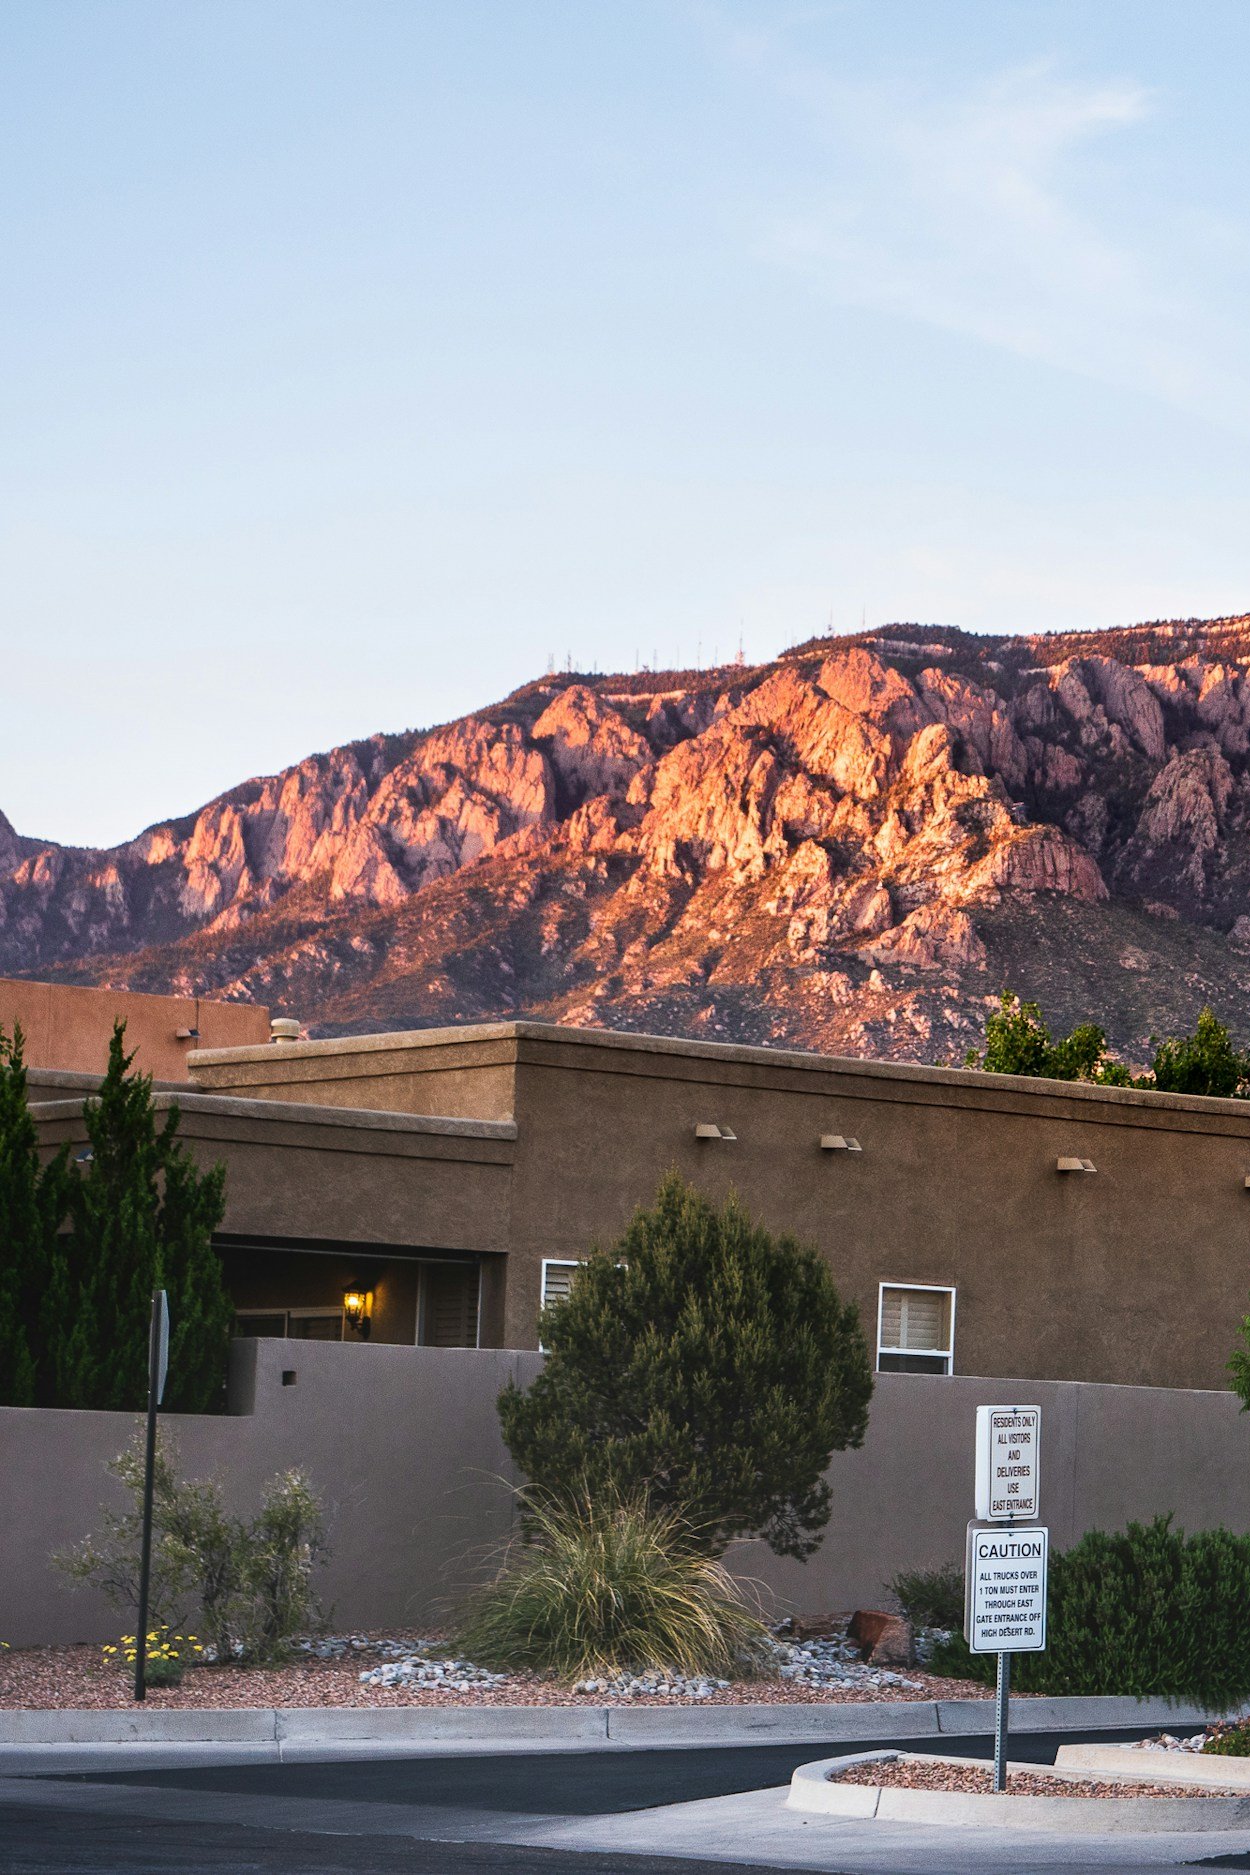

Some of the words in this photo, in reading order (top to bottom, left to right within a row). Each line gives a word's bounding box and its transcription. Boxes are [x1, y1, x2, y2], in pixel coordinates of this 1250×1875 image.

[993, 1417, 1022, 1428] RESIDENTS
[1022, 1416, 1036, 1427] ONLY
[998, 1434, 1007, 1444] ALL
[1008, 1433, 1031, 1444] VISITORS
[1007, 1450, 1021, 1460] AND
[997, 1466, 1031, 1478] DELIVERIES
[1007, 1482, 1019, 1494] USE
[992, 1500, 1006, 1511] EAST
[1006, 1498, 1033, 1510] ENTRANCE
[979, 1543, 1041, 1558] CAUTION
[980, 1572, 991, 1581] ALL
[993, 1571, 1019, 1580] TRUCKS
[1021, 1571, 1038, 1579] OVER
[985, 1586, 998, 1595] TON
[1000, 1585, 1018, 1594] MUST
[1019, 1585, 1039, 1593] ENTER
[985, 1600, 1016, 1609] THROUGH
[1017, 1599, 1033, 1607] EAST
[976, 1615, 993, 1623] GATE
[994, 1613, 1027, 1623] ENTRANCE
[1029, 1613, 1041, 1621] OFF
[981, 1629, 997, 1637] HIGH
[999, 1628, 1023, 1637] DESERT
[1024, 1628, 1035, 1636] RD.
